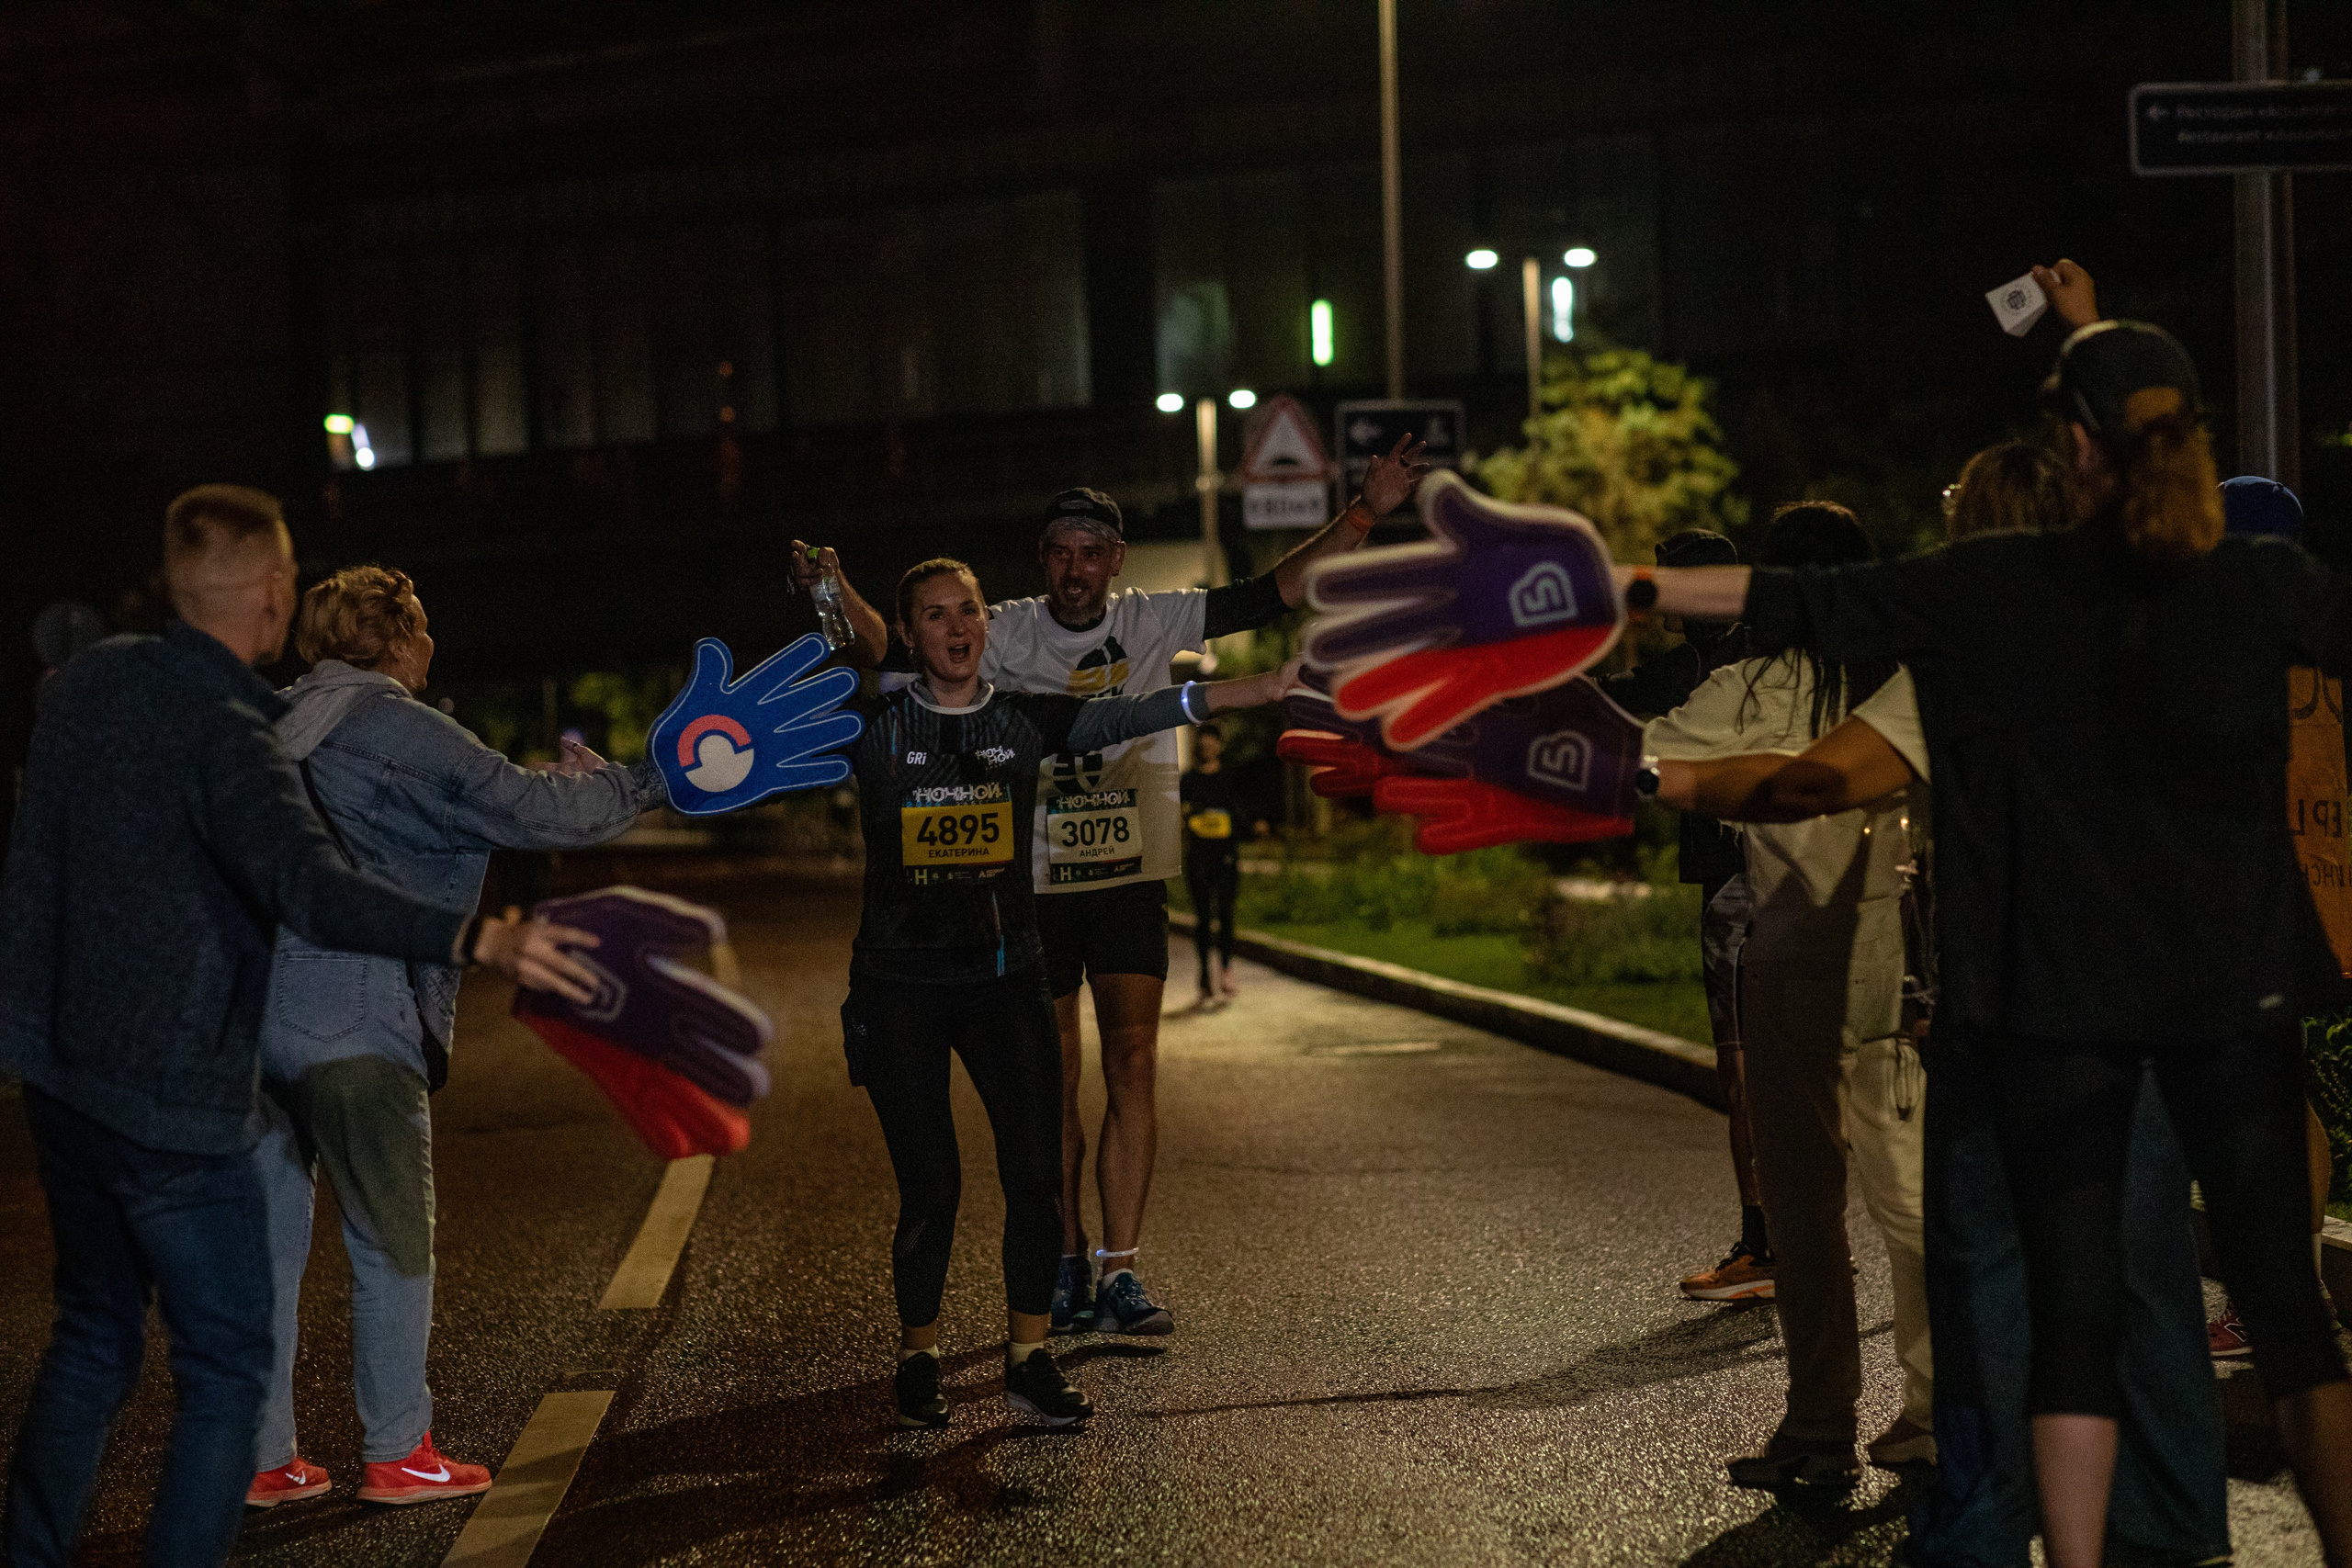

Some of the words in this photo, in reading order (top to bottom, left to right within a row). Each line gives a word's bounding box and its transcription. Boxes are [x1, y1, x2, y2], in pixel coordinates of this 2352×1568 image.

[917, 813, 999, 846] 4895
[1061, 817, 1129, 847] 3078
[928, 847, 989, 858] ЕКАТЕРИНА
[1080, 845, 1114, 858] АНДРЕЙ
